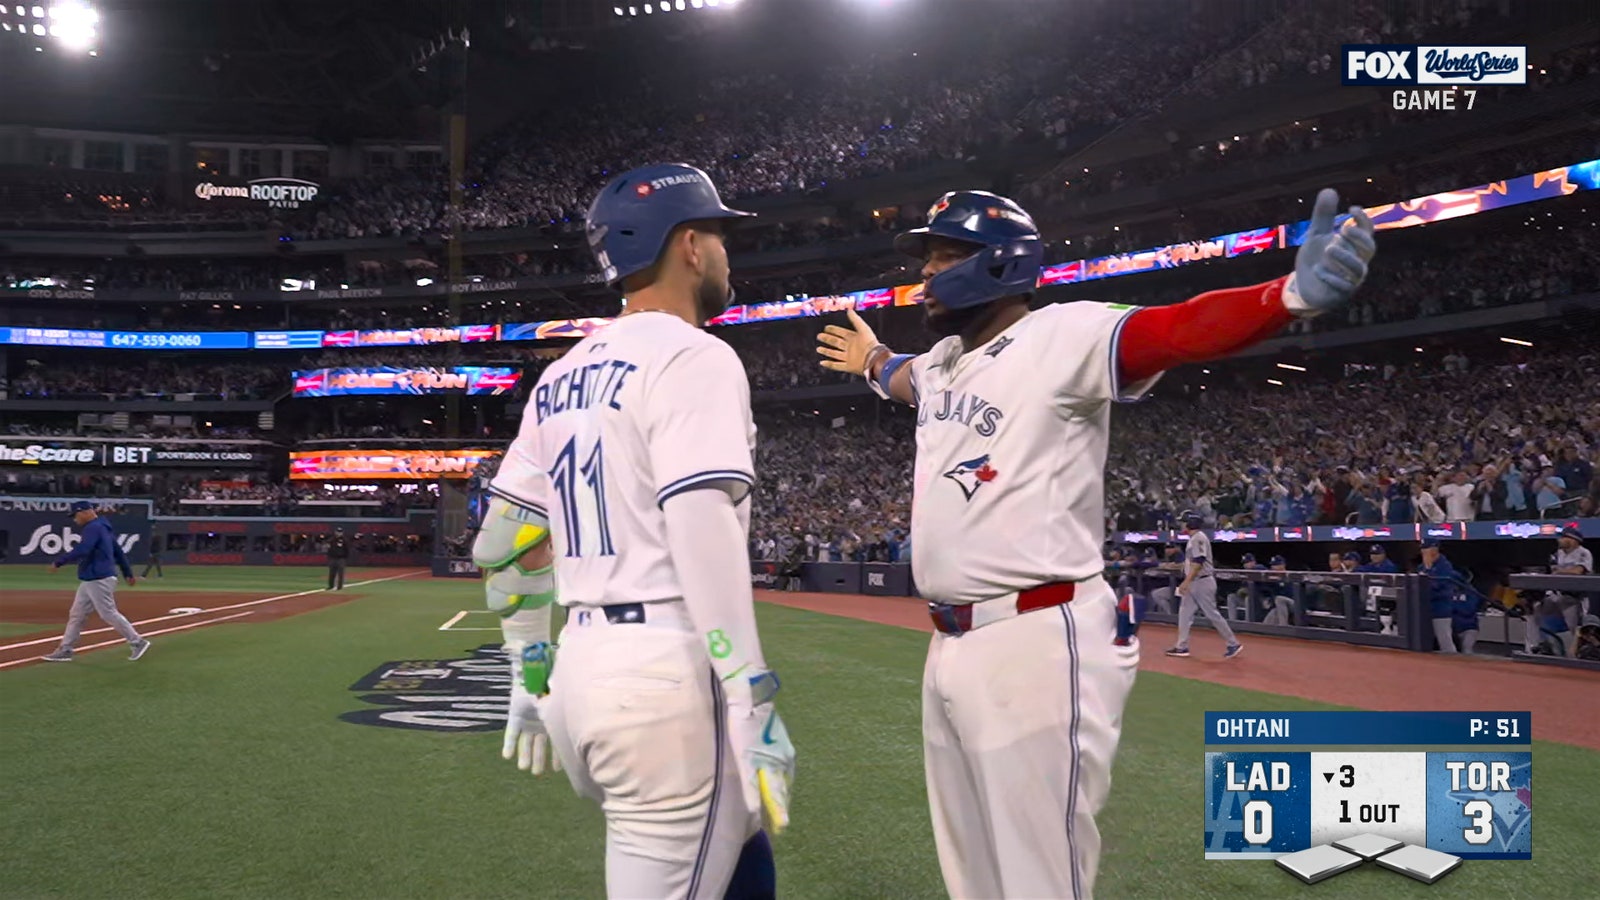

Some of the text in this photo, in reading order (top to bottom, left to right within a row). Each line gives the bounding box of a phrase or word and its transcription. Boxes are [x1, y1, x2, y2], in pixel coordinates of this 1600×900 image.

[195, 182, 318, 201] Corona ROOFTOP
[268, 200, 299, 209] PATIO
[112, 334, 201, 346] 647-559-0060
[935, 391, 1004, 437] JAYS
[113, 446, 151, 463] BET
[221, 452, 252, 460] CASINO
[548, 434, 616, 557] 11
